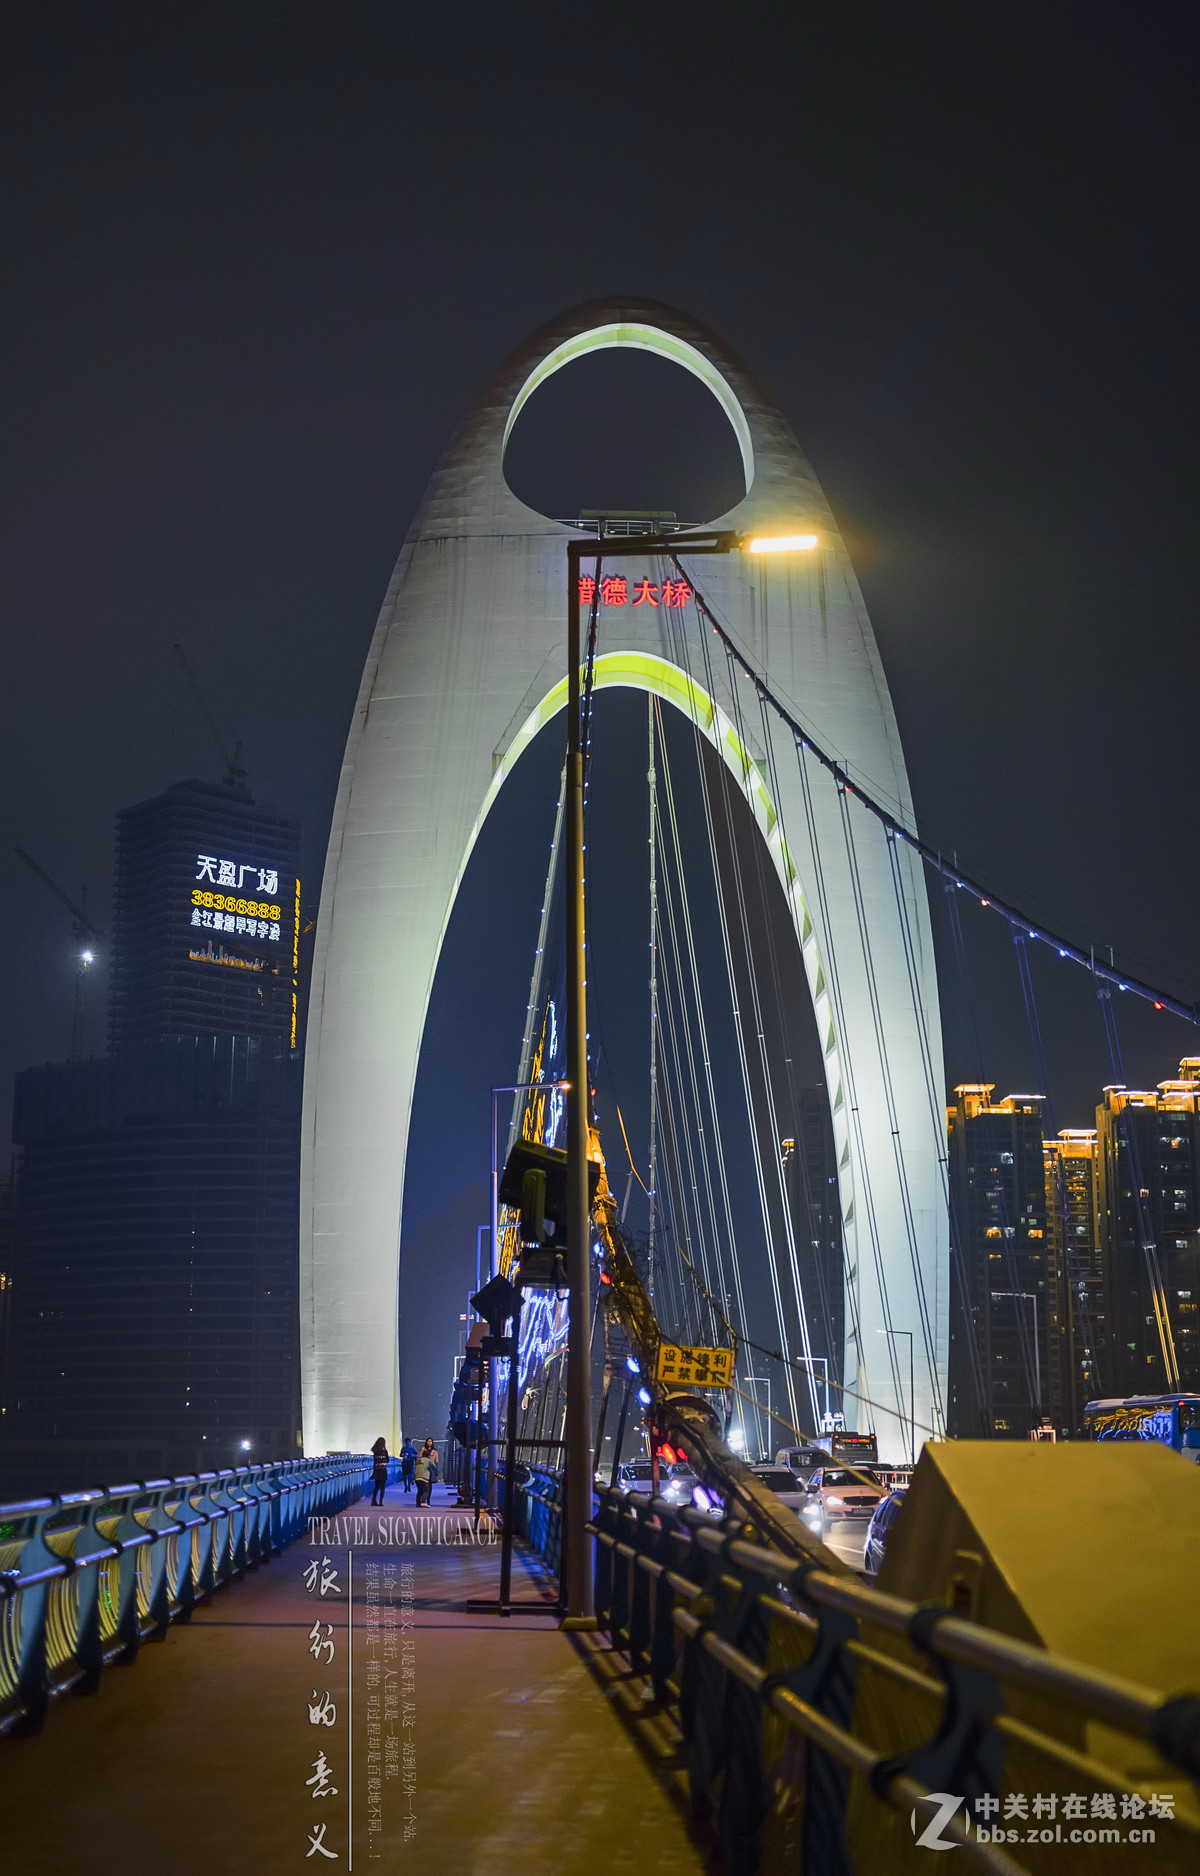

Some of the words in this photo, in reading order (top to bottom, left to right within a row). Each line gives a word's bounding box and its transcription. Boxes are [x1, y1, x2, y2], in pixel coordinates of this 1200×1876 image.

[195, 854, 279, 895] 天盈广场
[190, 889, 281, 921] 38366888
[664, 1348, 727, 1368] 设施锋利
[662, 1365, 725, 1385] 严禁攀爬
